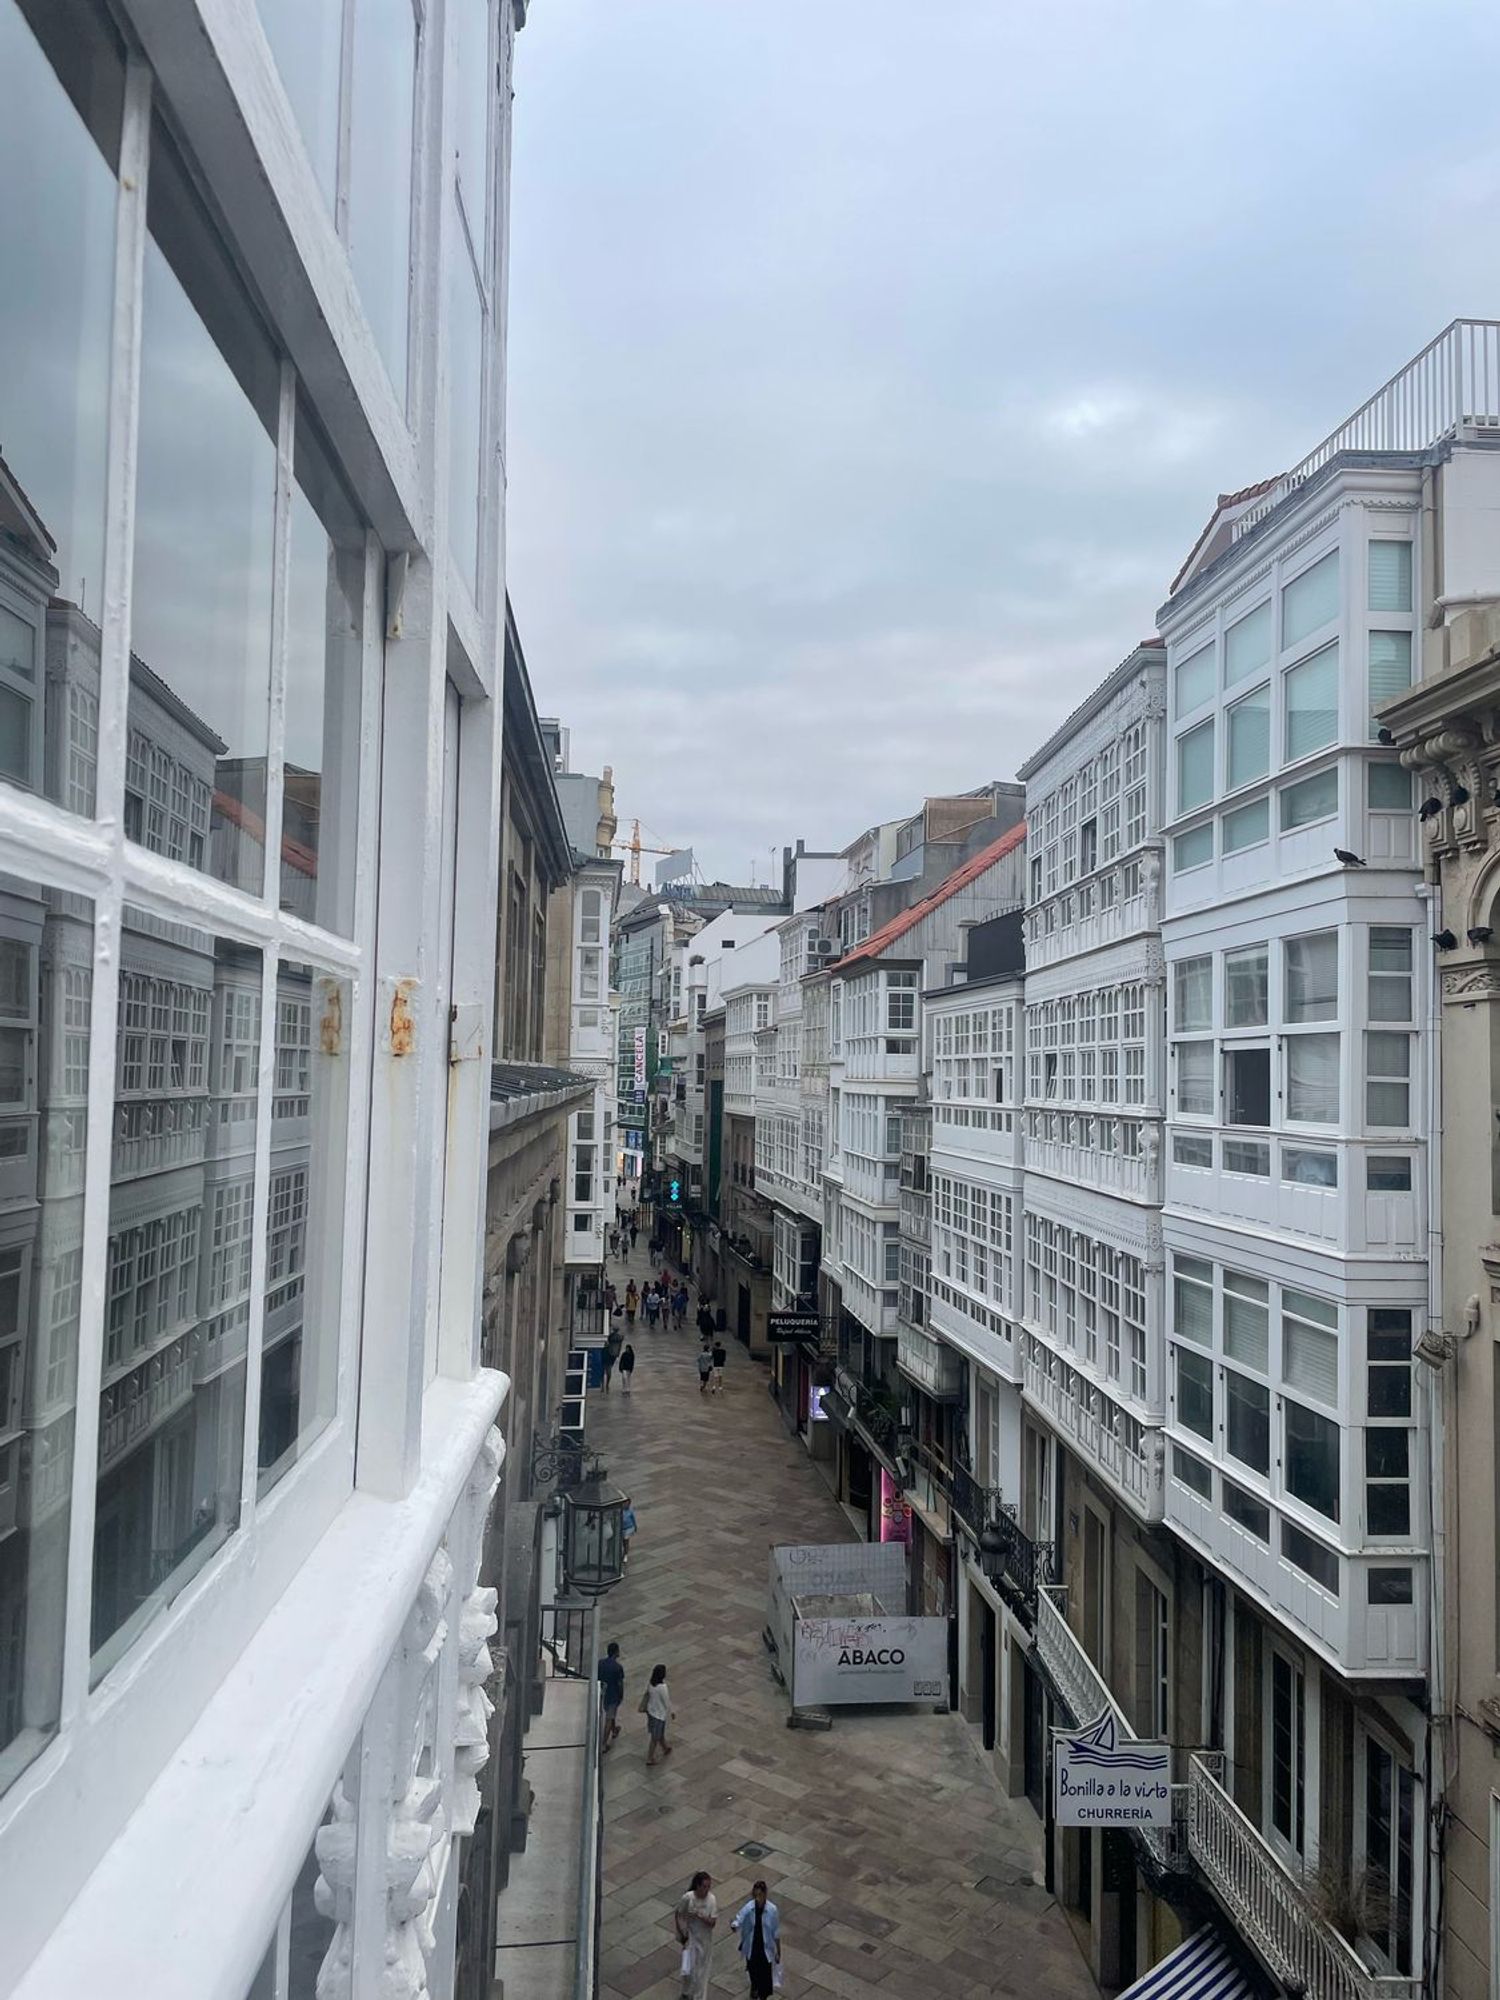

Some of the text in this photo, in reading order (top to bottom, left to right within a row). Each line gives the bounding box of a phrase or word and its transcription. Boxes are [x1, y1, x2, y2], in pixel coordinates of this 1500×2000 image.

[635, 1034, 644, 1084] CANCELA
[1061, 1768, 1168, 1799] Bonilla a la vista
[1078, 1807, 1153, 1819] CHURRERÍA
